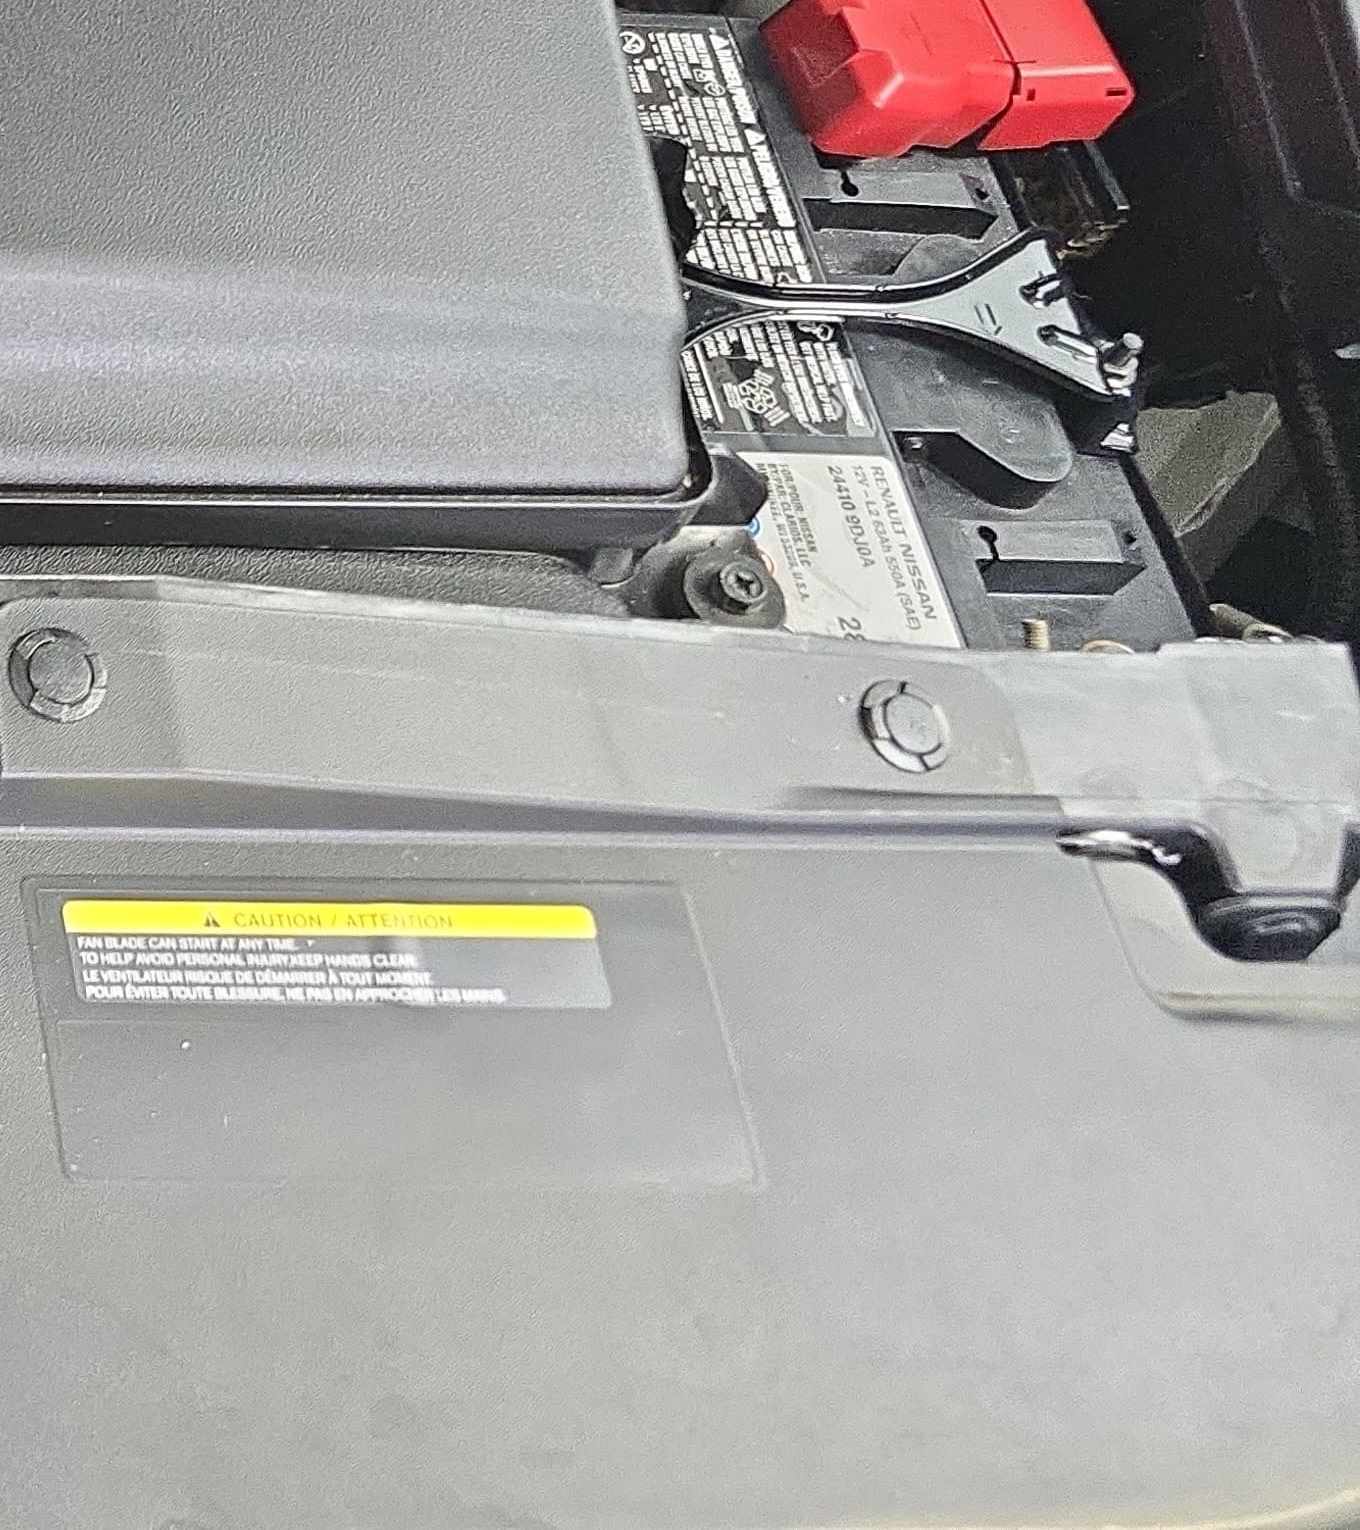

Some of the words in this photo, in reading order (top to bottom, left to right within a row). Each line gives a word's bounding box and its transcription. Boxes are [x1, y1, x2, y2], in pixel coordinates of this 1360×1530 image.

[827, 465, 856, 511] 24410
[798, 517, 818, 553] NISSAN
[852, 464, 869, 488] 12V
[865, 501, 879, 518] L2
[885, 556, 906, 590] 550A
[896, 592, 922, 631] (SAE)
[870, 465, 908, 538] RENAULT
[899, 543, 938, 620] NISSAN
[796, 548, 811, 568] LLC
[234, 913, 322, 928] CAUTION
[330, 914, 337, 927] /
[347, 914, 453, 929] ATTENTION
[77, 936, 102, 949] FAN
[105, 937, 147, 950] BLADE
[148, 937, 178, 950] CAN
[179, 937, 218, 950] START
[221, 938, 236, 950] AT
[237, 938, 264, 951] ANY
